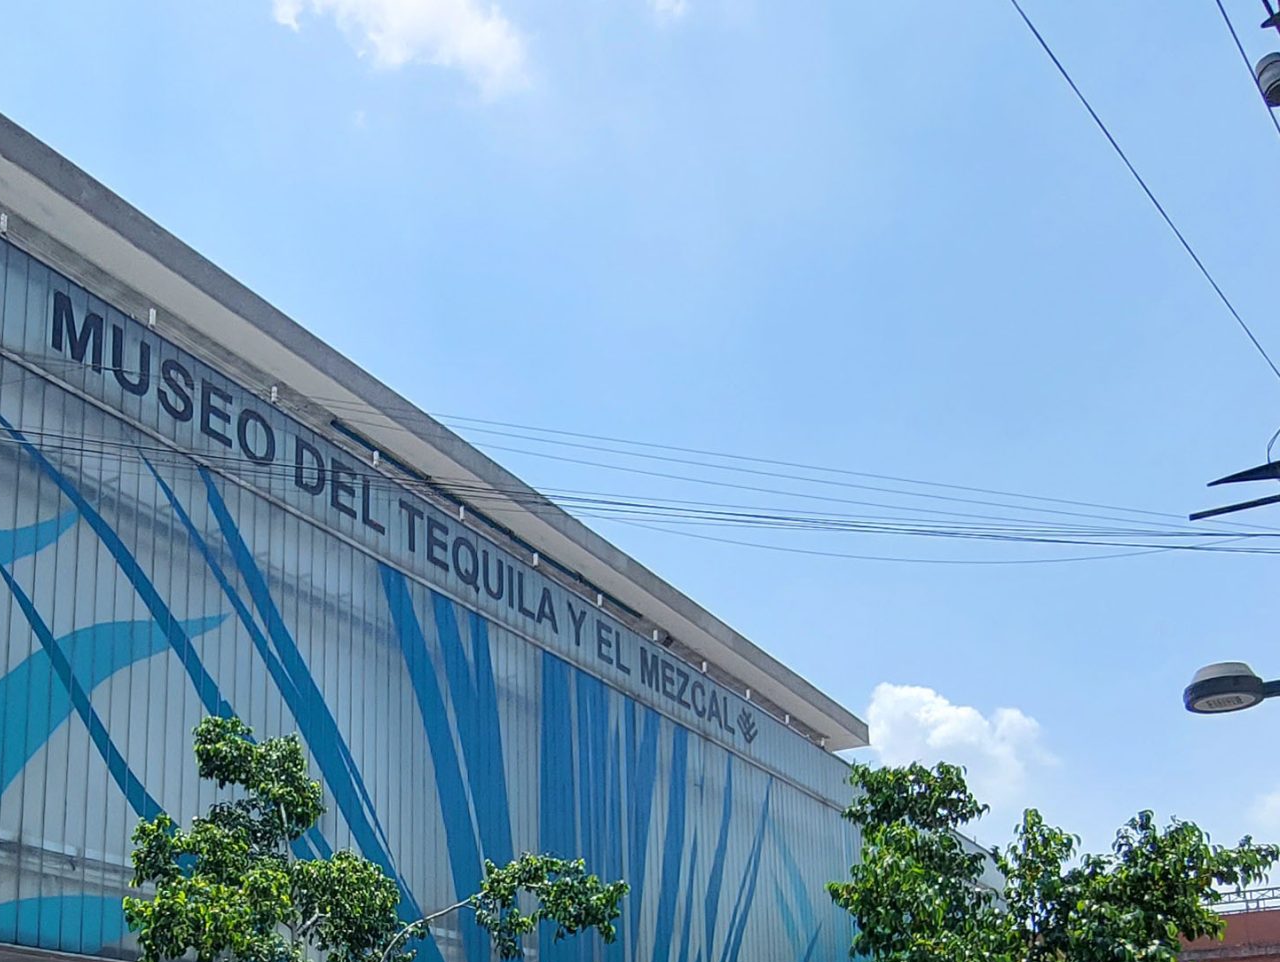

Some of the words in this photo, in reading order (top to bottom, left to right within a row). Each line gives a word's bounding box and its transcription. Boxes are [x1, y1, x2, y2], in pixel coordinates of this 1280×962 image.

[52, 291, 276, 465] MUSEO
[295, 435, 386, 536] DEL
[398, 498, 559, 635] TEQUILA
[567, 600, 587, 647] Y
[596, 618, 631, 676] EL
[640, 646, 736, 736] MEZCAL
